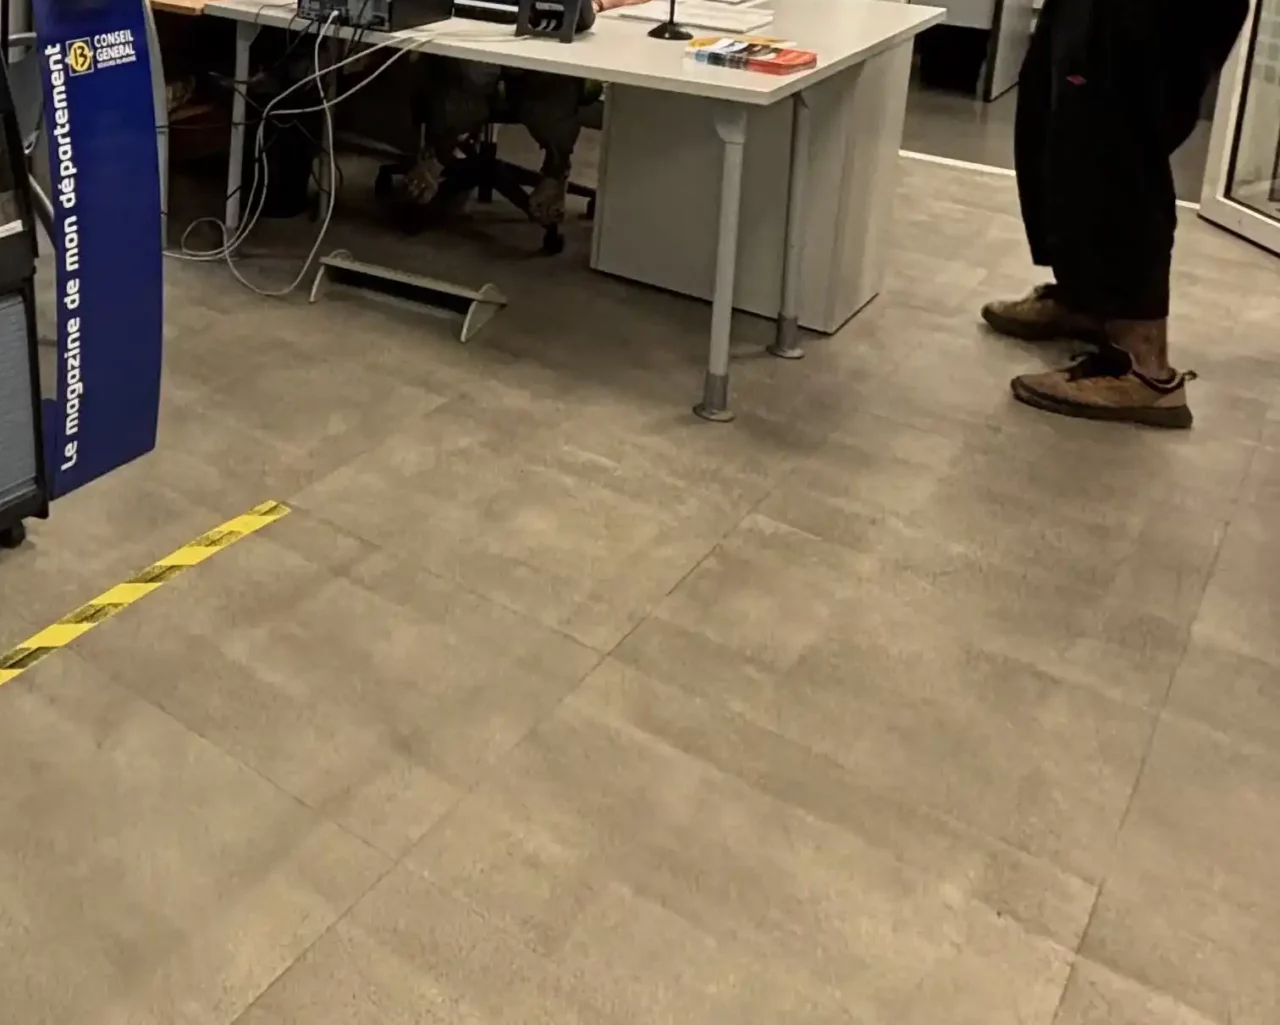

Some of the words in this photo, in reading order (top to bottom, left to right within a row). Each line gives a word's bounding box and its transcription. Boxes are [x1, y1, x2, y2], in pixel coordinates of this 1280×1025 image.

[94, 29, 134, 48] CONSEIL
[96, 43, 136, 61] GENERAL
[44, 43, 77, 209] département
[63, 215, 80, 271] mon
[63, 278, 80, 310] de
[64, 316, 83, 436] magazine
[61, 440, 78, 471] Le
